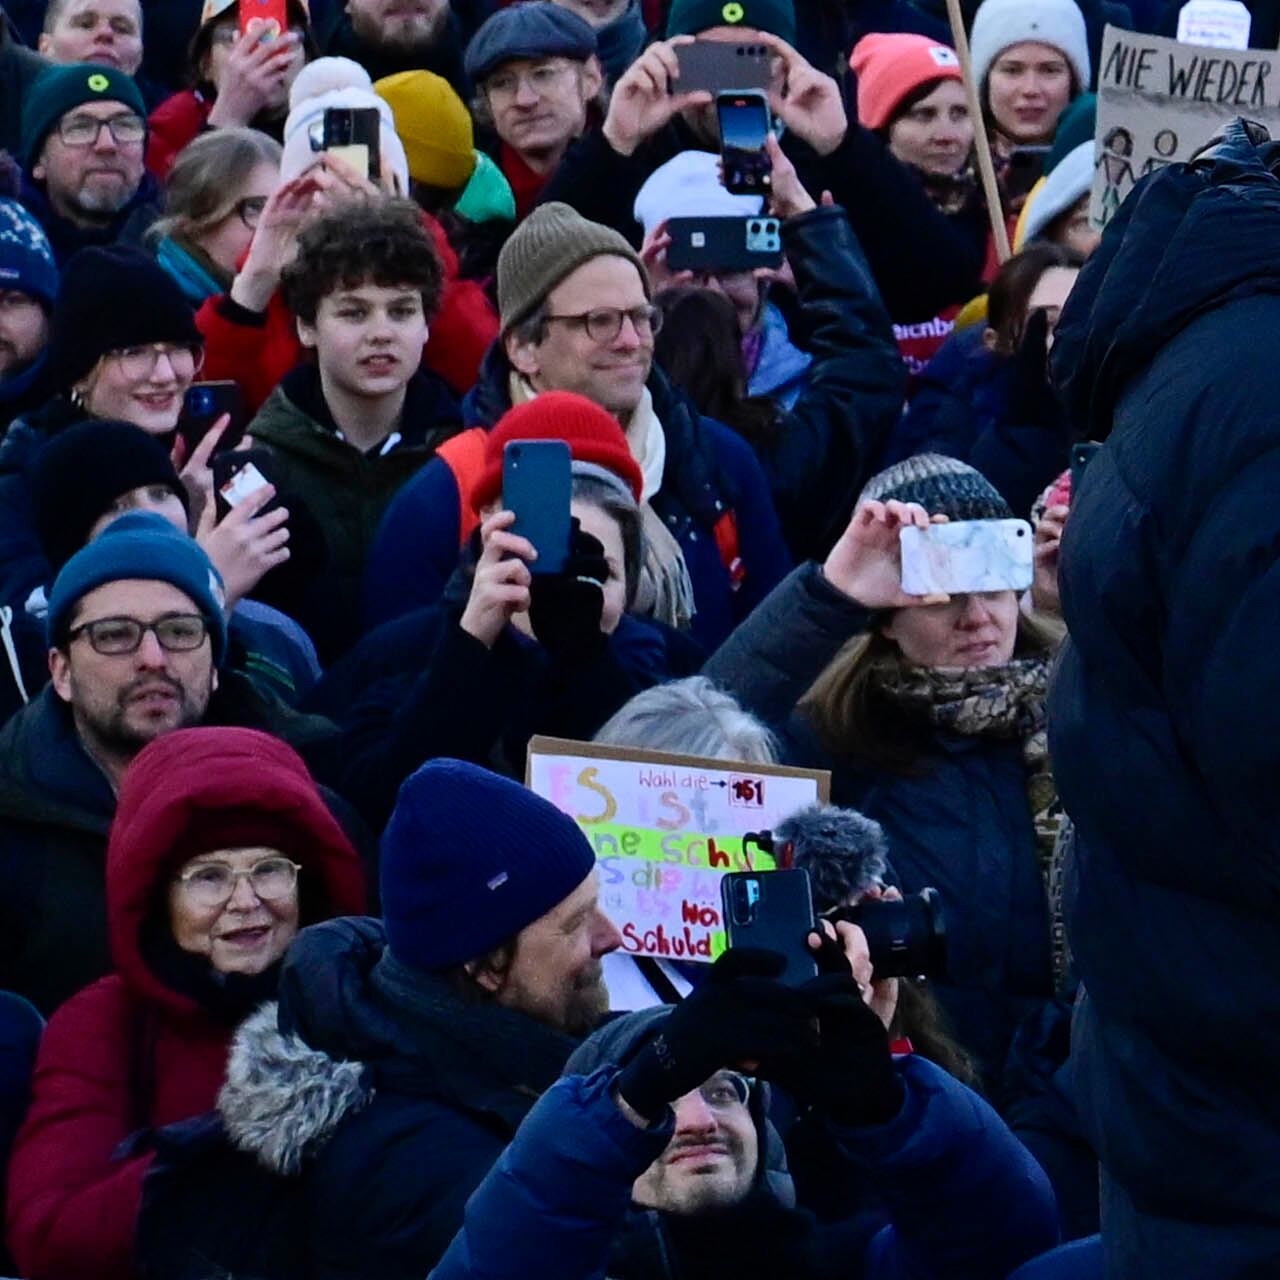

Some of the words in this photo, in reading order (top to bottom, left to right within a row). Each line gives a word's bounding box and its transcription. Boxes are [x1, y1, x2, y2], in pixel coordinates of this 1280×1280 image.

[1103, 41, 1153, 91] NIE
[1167, 52, 1266, 109] WIEDER
[593, 828, 641, 856] ne
[621, 922, 713, 958] Schuld
